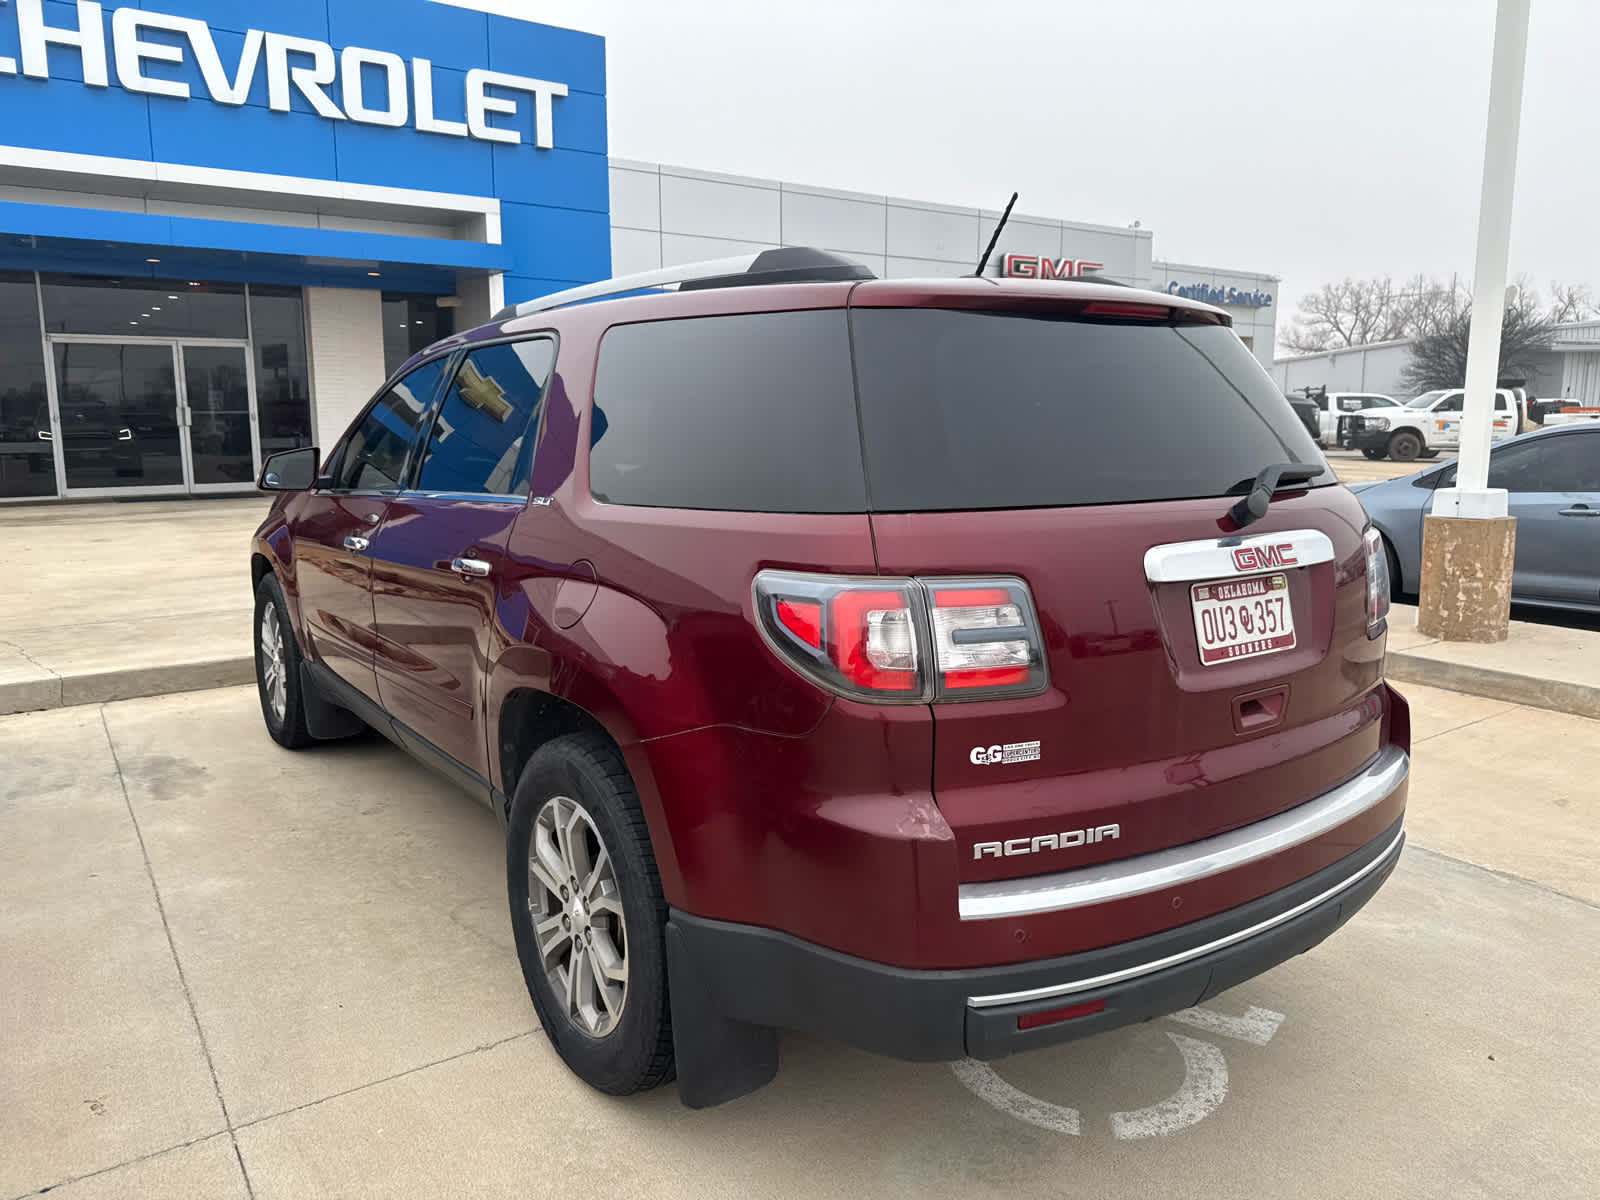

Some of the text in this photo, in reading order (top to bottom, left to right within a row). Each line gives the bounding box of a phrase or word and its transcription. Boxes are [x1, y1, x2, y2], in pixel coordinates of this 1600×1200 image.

[0, 0, 569, 149] HEVROLET
[1168, 281, 1273, 307] Certified Service
[1232, 543, 1298, 571] GMC
[1218, 580, 1266, 599] OKLAHOMA
[1255, 597, 1285, 635] 357
[1228, 639, 1272, 657] SOONERS
[973, 823, 1120, 859] ACADIA
